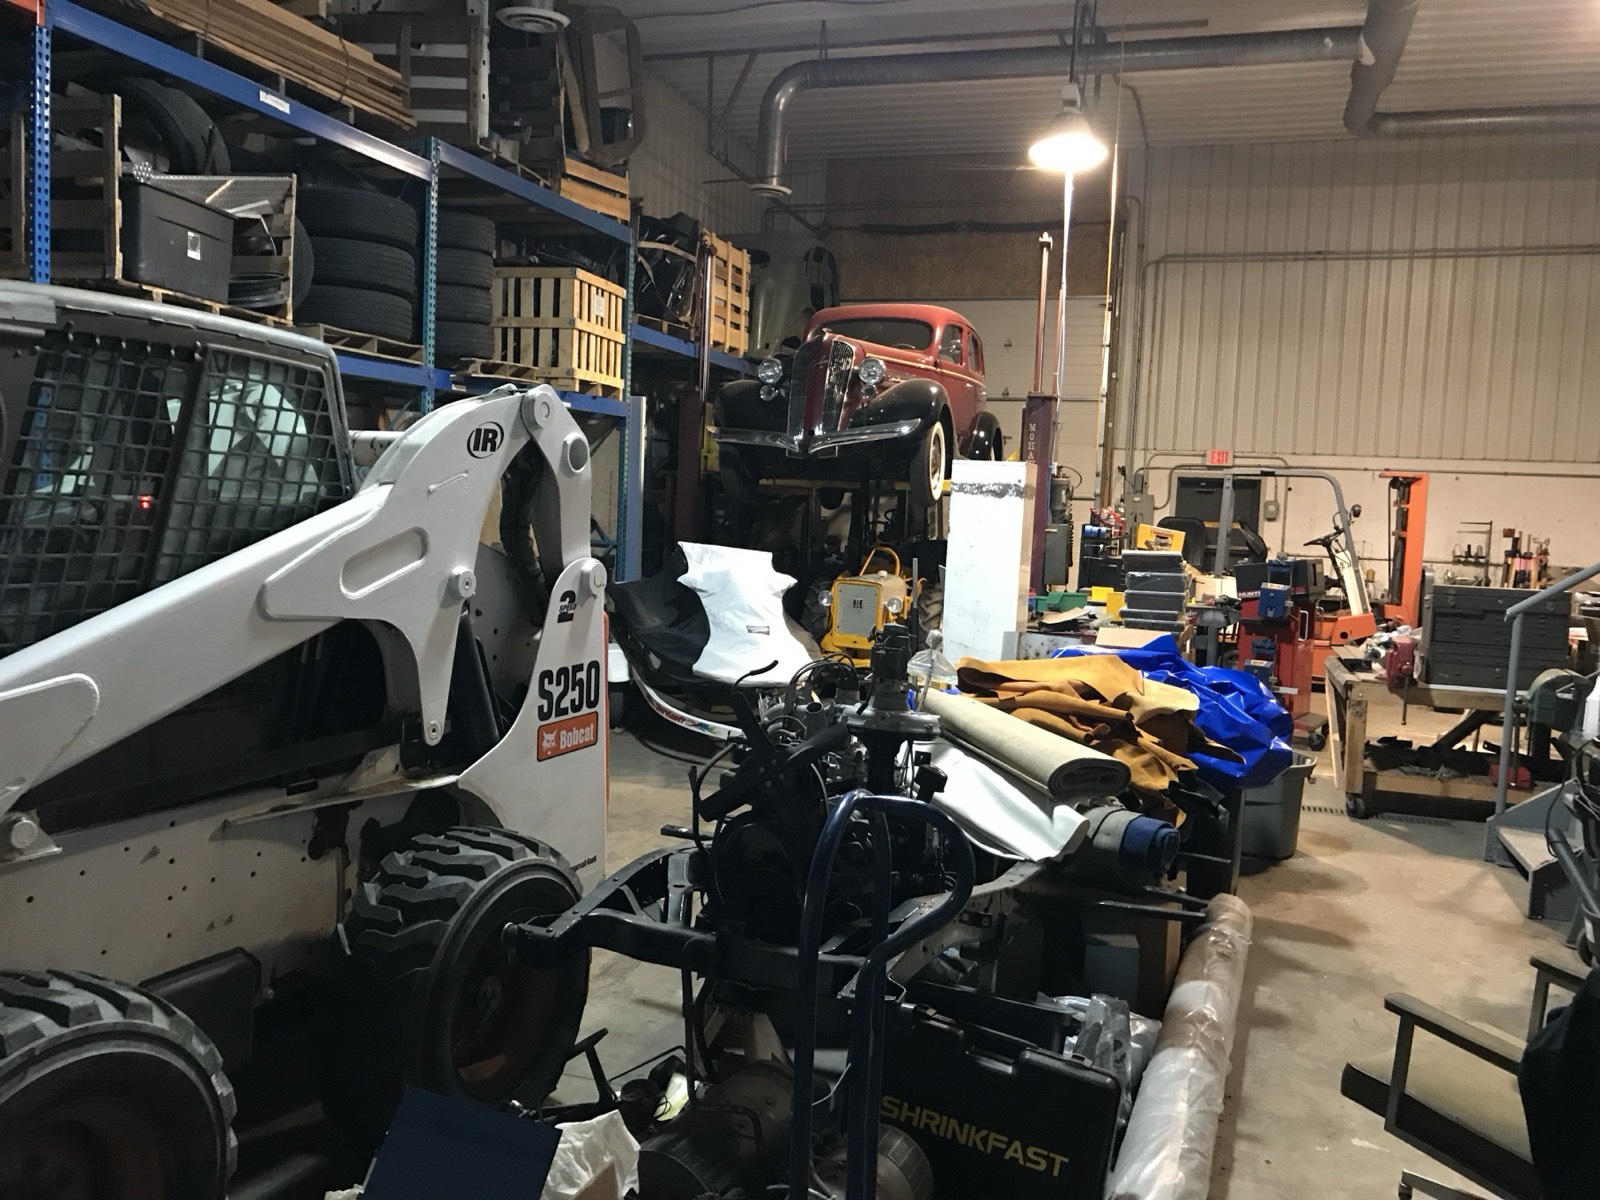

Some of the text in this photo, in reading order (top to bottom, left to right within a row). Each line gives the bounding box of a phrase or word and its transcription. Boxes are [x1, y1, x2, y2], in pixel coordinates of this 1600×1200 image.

[472, 427, 498, 453] IR
[1209, 450, 1229, 465] EXIT
[557, 590, 577, 623] 2
[559, 603, 577, 612] SPEED
[537, 660, 600, 722] S250
[559, 722, 594, 749] Bobcat
[879, 1095, 1069, 1177] SHRINKFAST
